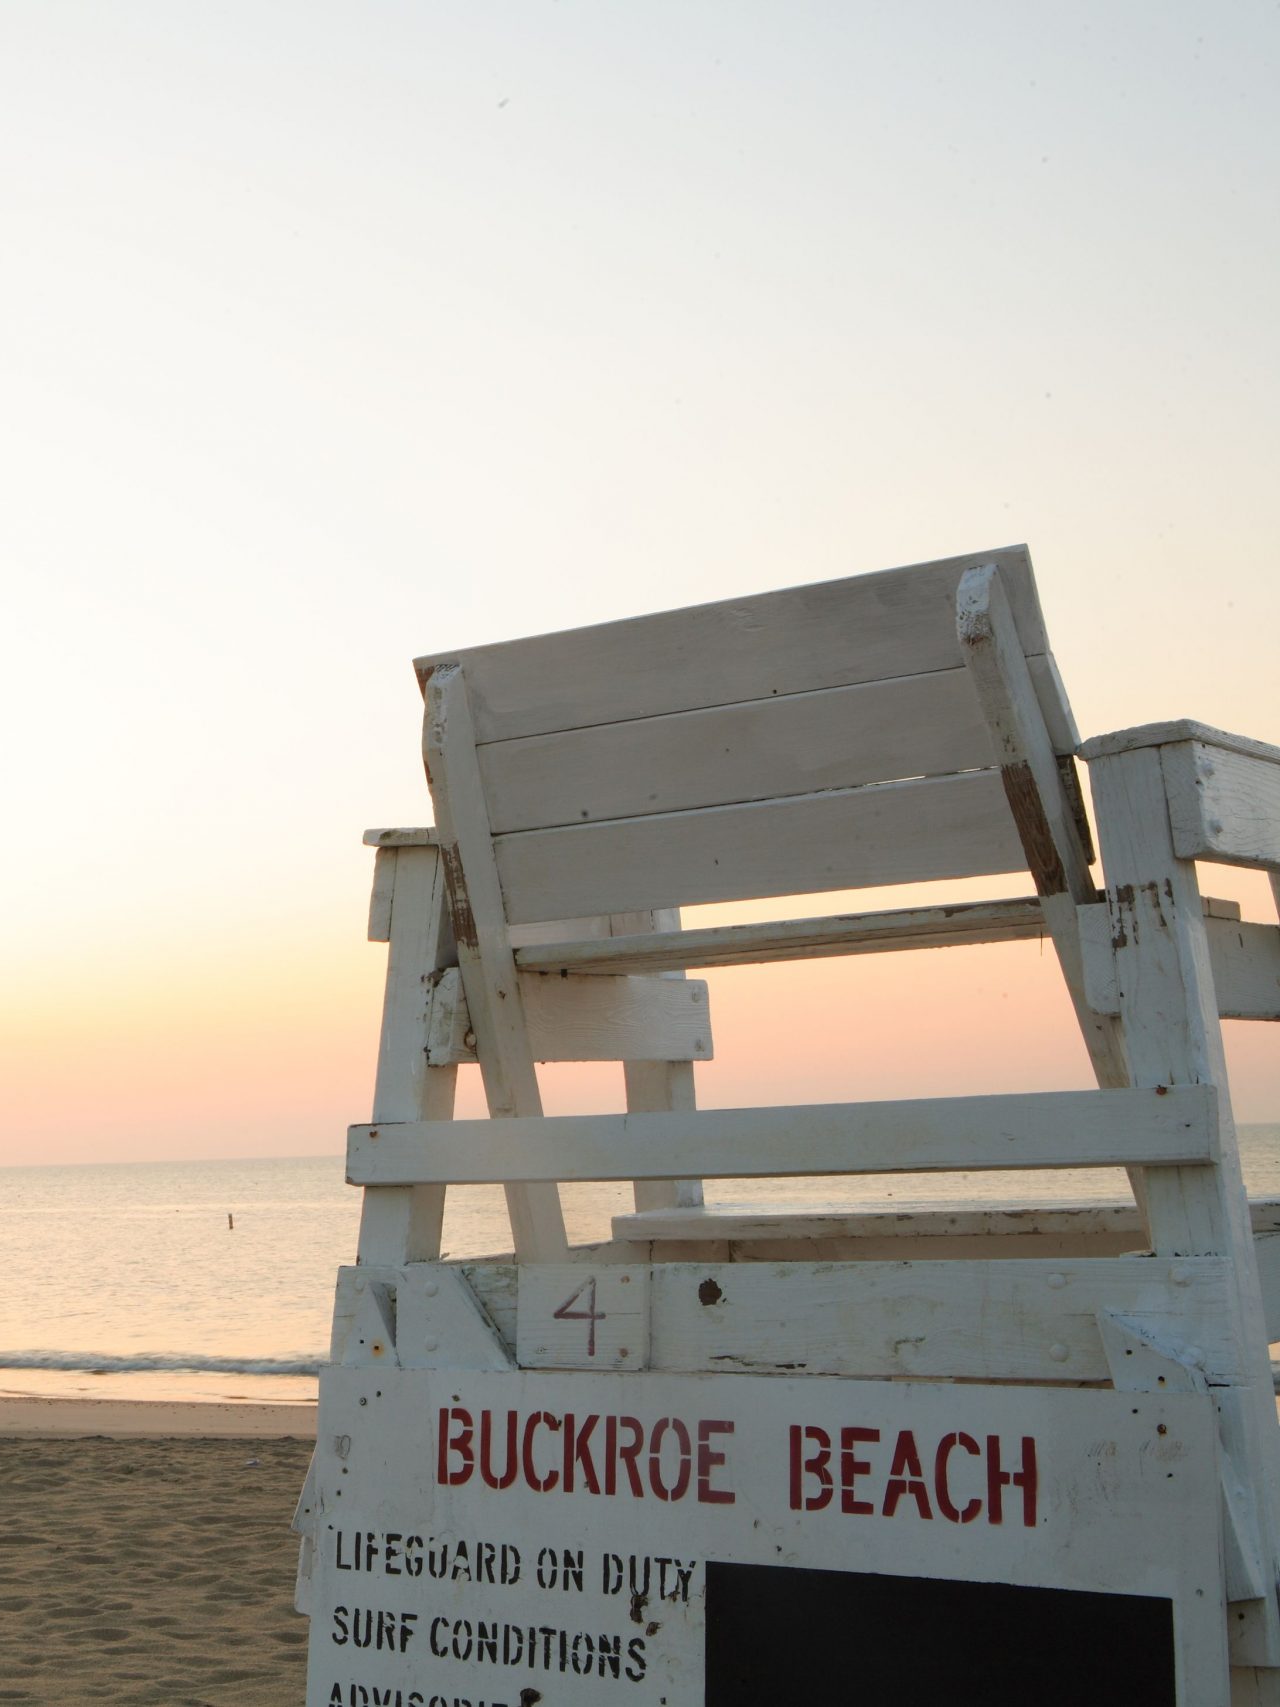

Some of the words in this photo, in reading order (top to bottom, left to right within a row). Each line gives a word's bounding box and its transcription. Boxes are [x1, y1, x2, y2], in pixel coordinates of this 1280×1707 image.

[553, 1275, 605, 1357] 4
[437, 1407, 736, 1504] BUCKROE
[789, 1424, 1038, 1528] BEACH
[336, 1531, 521, 1585] LIFEGUARD
[536, 1547, 584, 1592] ON
[602, 1553, 696, 1602] DUTY
[332, 1606, 418, 1653] SURF
[429, 1616, 648, 1683] CONDITIONS
